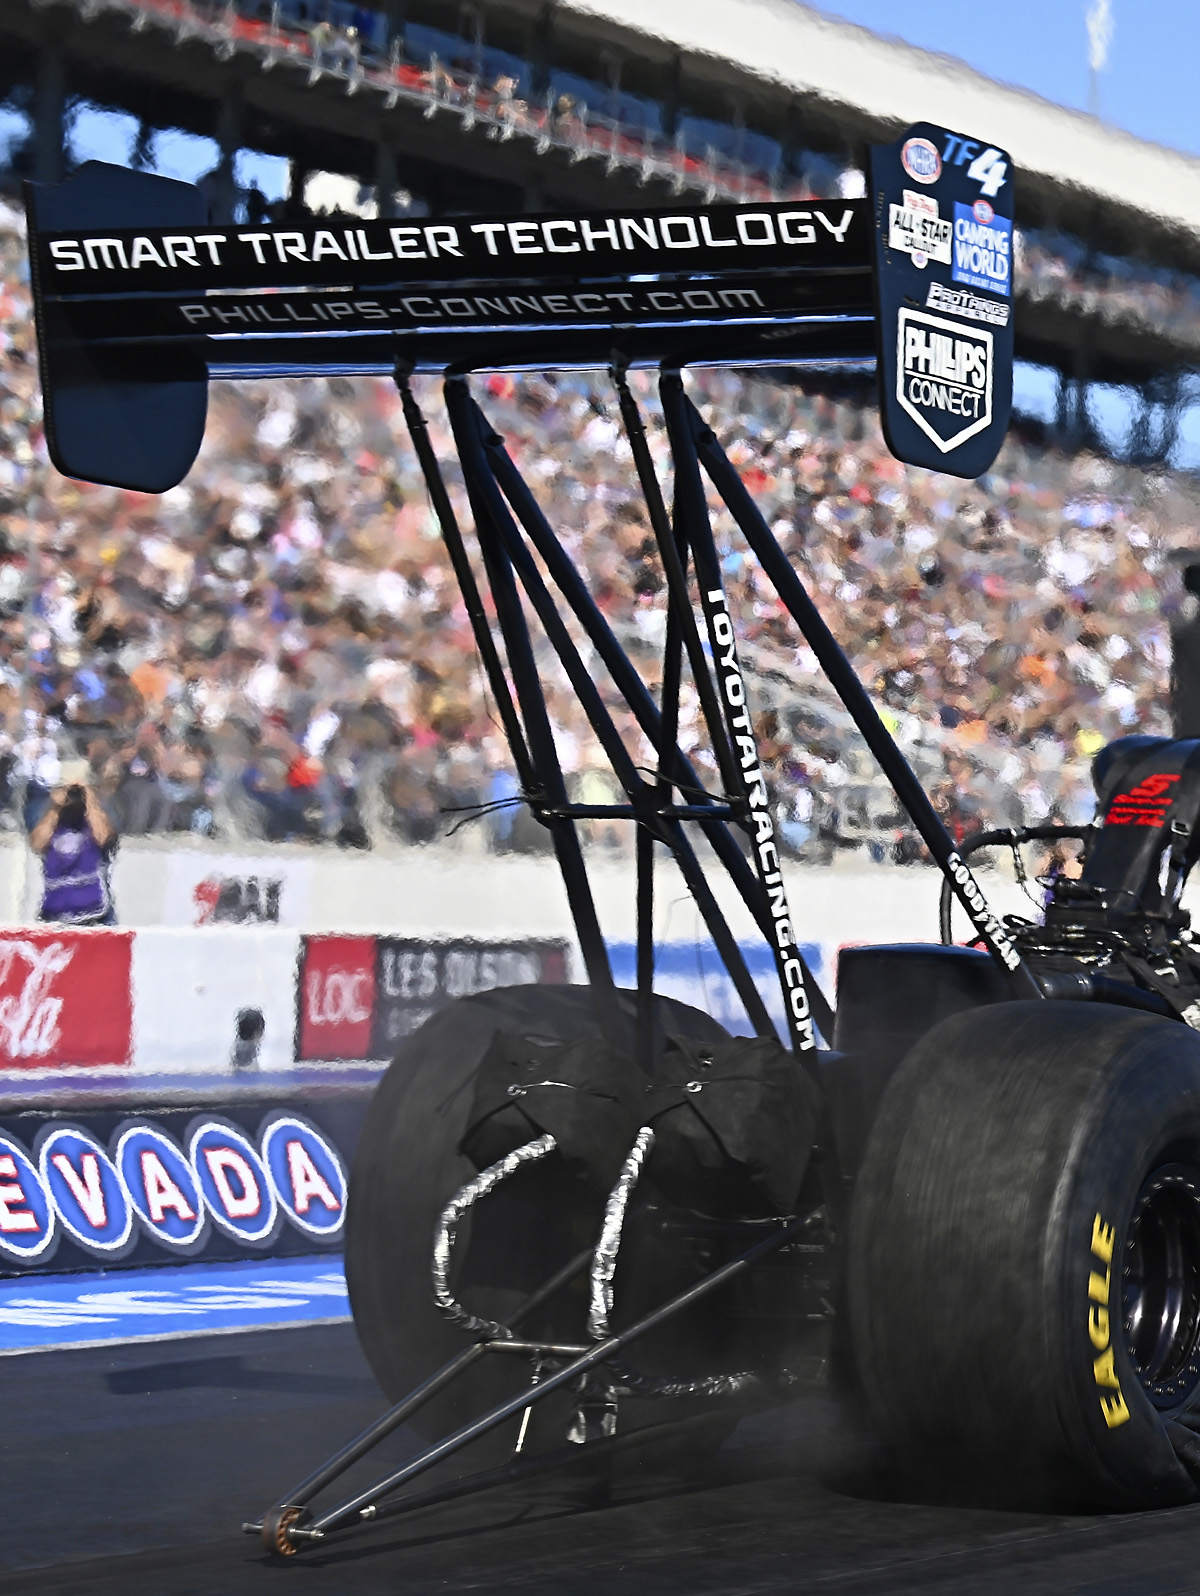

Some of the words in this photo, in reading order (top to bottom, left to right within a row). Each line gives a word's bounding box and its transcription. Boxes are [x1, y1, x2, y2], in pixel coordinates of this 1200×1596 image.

[49, 234, 226, 271] SMART
[237, 225, 465, 264] TRAILER
[470, 209, 854, 256] TECHNOLOGY
[955, 218, 1009, 254] CAMPING
[955, 240, 1008, 281] WORLD
[179, 289, 765, 325] PHILLIPS-CONNECT.COM
[904, 325, 986, 389] PHILLIPS
[908, 378, 981, 419] CONNECT
[1088, 1212, 1131, 1429] EAGLE
